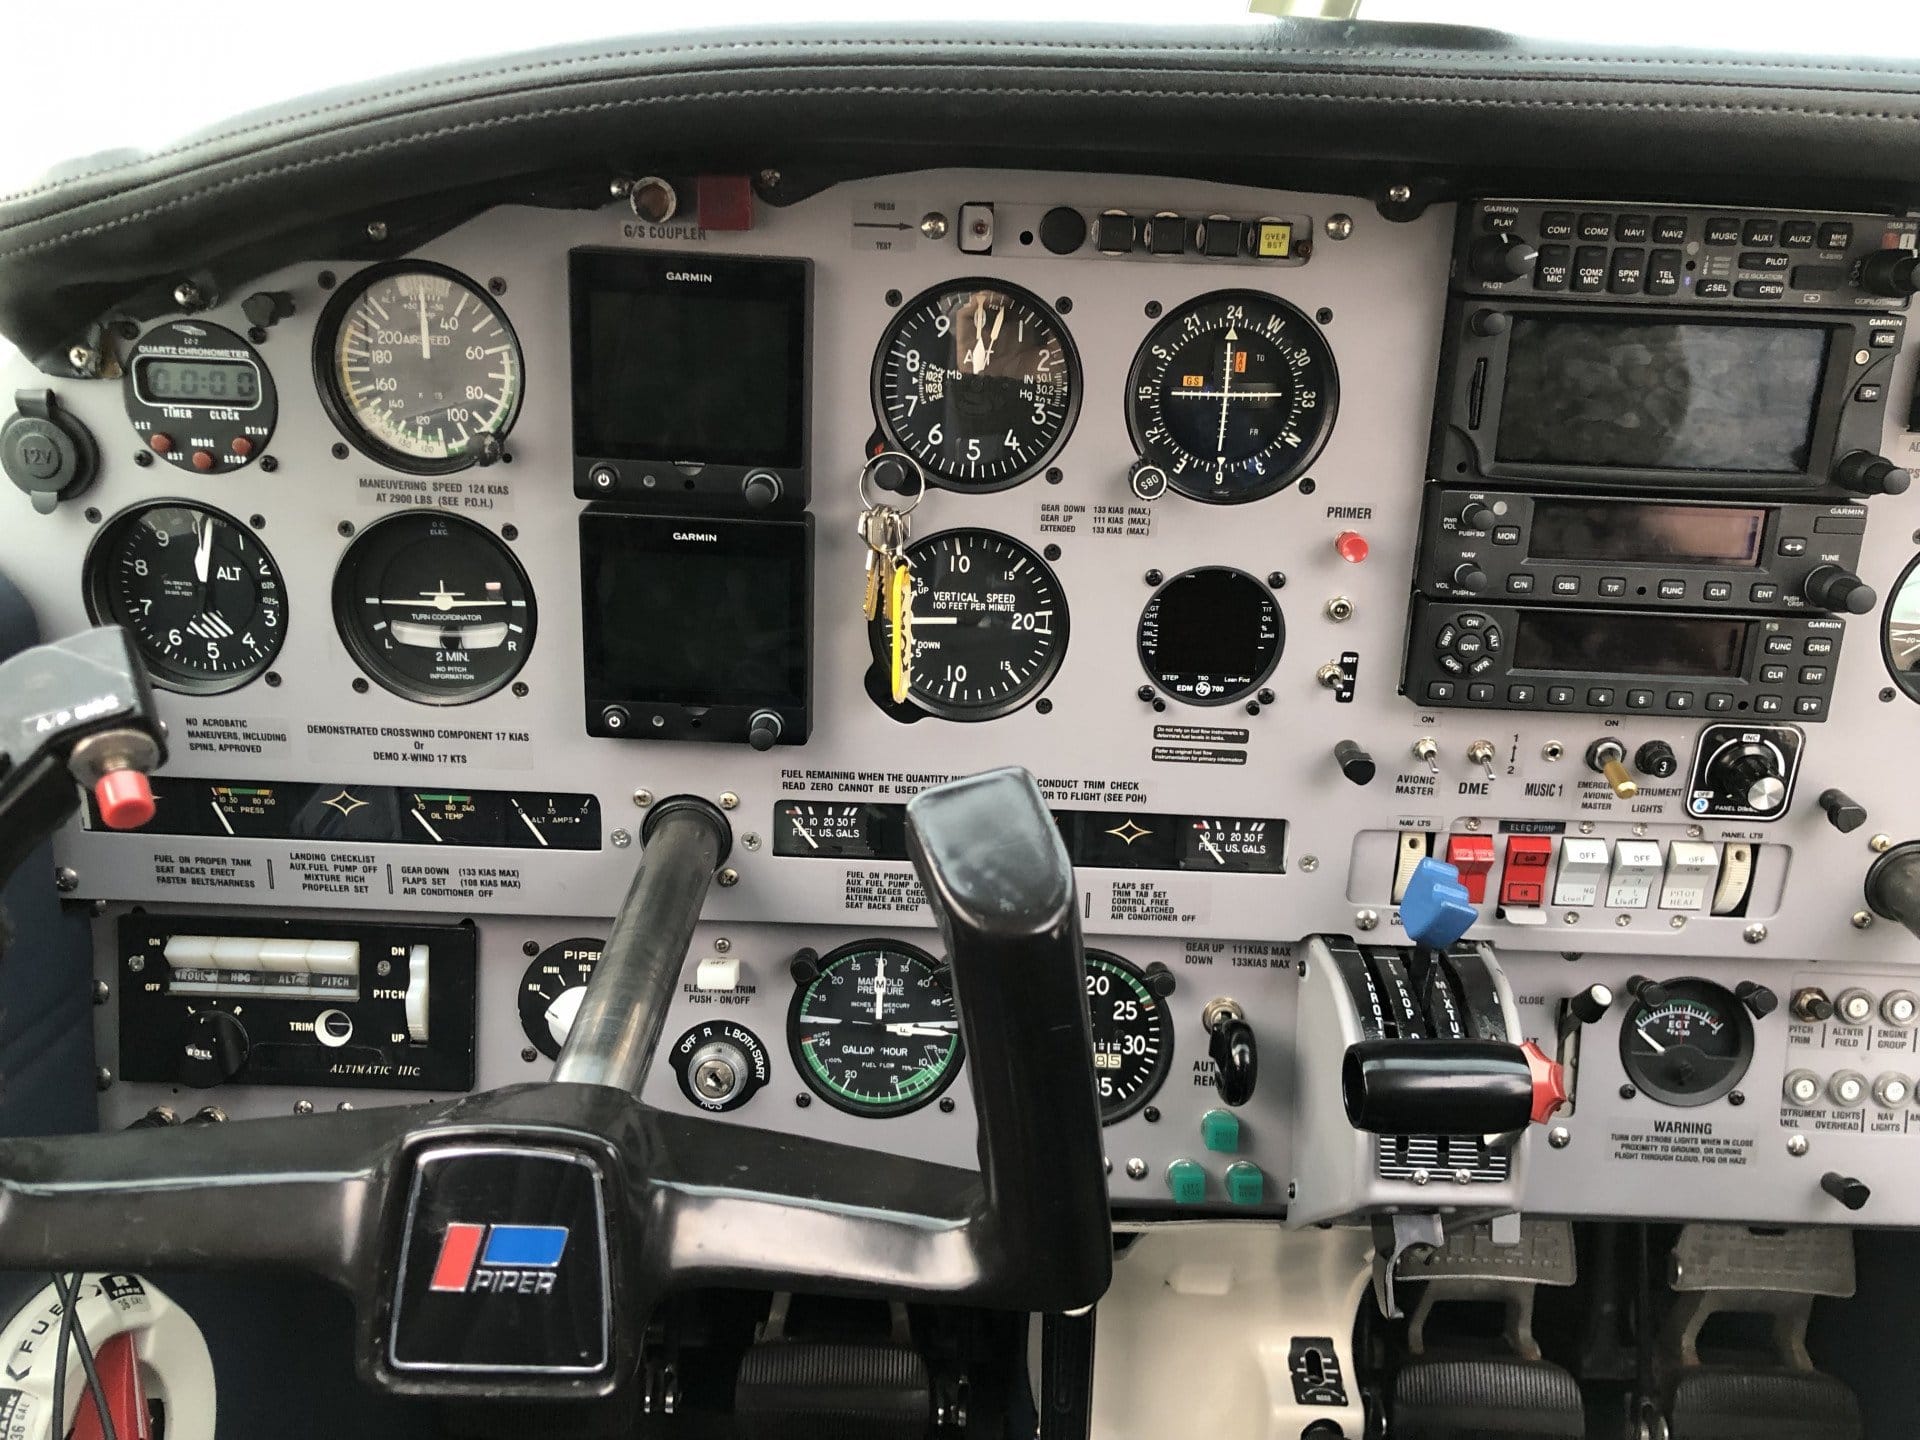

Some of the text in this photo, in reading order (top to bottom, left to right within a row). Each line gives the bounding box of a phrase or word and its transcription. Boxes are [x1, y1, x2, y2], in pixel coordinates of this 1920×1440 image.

[624, 226, 706, 241] G/S COUPLER
[1547, 226, 1571, 234] COM1
[1584, 227, 1609, 236] COM2
[1624, 228, 1645, 236] NAV1
[1661, 230, 1684, 238] NAV2
[1711, 232, 1738, 240] MUSIC
[1752, 234, 1773, 242] AUX1
[1789, 235, 1811, 243] AUX2
[1267, 241, 1283, 249] BST
[1765, 257, 1788, 266] PILOT
[1543, 267, 1566, 275] COM1
[1579, 269, 1603, 277] COM2
[666, 272, 712, 283] GARMIN
[1546, 275, 1563, 283] MIC
[1583, 276, 1599, 284] MIC
[1759, 286, 1784, 294] CREW
[1227, 305, 1243, 319] 24
[1869, 318, 1903, 326] GARMIN
[378, 330, 402, 345] 200
[138, 345, 250, 359] QUARTZ CHRONOMETER
[372, 350, 393, 364] 180
[465, 346, 484, 360] 60
[946, 370, 962, 380] Mb
[1186, 376, 1200, 386] GS
[465, 386, 484, 400] 80
[925, 384, 943, 393] 1020
[1035, 386, 1054, 395] 30.2
[1019, 389, 1033, 401] Hg
[163, 408, 192, 419] TIMER
[210, 410, 240, 421] CLOCK
[447, 408, 469, 422] 100
[966, 439, 981, 460] 5
[359, 478, 510, 496] MANEUVERING SPEED 124 KIAS
[1140, 474, 1159, 490] OBS
[376, 492, 494, 509] AT 2900 LBS (SEE P.O.H.)
[1041, 504, 1151, 516] GEAR DOWN 133 KIAS (MAX.)
[1326, 506, 1372, 519] PRIMER
[1830, 508, 1864, 516] GARMIN
[1040, 514, 1059, 522] GEAR
[1063, 515, 1073, 523] UP
[1093, 516, 1106, 524] 111
[1127, 517, 1151, 526] (MAX.)
[1040, 525, 1076, 533] EXTENDED
[1092, 526, 1105, 534] 133
[1126, 527, 1150, 536] (MAX.)
[672, 532, 717, 542] GARMIN
[1497, 532, 1516, 541] MON
[951, 555, 971, 573] 10
[216, 567, 241, 581] ALT
[918, 586, 929, 595] UP
[1558, 582, 1575, 590] OBS
[1661, 586, 1684, 595] FUNC
[933, 591, 1016, 604] VERTICAL SPEED
[1710, 588, 1726, 596] CLR
[1757, 590, 1773, 598] ENT
[932, 601, 1015, 612] 100 FEET PER MINUTE
[411, 613, 482, 622] TURN COORDINATOR
[1011, 613, 1035, 630] 20
[1808, 621, 1841, 629] GARMIN
[917, 641, 940, 650] DOWN
[1769, 642, 1792, 650] FUNC
[435, 652, 470, 662] 2 MIN.
[1176, 684, 1193, 692] EDM
[185, 718, 248, 728] NO ACROBATIC
[187, 730, 287, 742] MANEUVERS, INCLUDING
[307, 725, 530, 742] DEMONSTRATED CROSSWIND COMPONENT 17 KIAS
[189, 743, 262, 753] SPINS, APPROVED
[413, 741, 424, 750] Or
[373, 751, 467, 764] DEMO X-WIND 17 KTS
[781, 769, 949, 784] FUEL REMAINING WHEN THE QUANTITY
[1397, 774, 1435, 785] AVIONIC
[782, 782, 918, 795] READ ZERO CANNOT BE USED
[1037, 778, 1139, 791] CONDUCT TRIM CHECK
[1458, 782, 1489, 795] DME
[1524, 782, 1563, 797] MUSIC 1
[1395, 786, 1434, 796] MASTER
[1057, 792, 1148, 804] TO FLIGHT (SEE POH)
[1631, 804, 1663, 814] LIGHTS
[836, 828, 860, 838] GALS
[290, 852, 375, 864] LANDING CHECKLIST
[1185, 943, 1292, 956] GEAR UP 111KIAS MAX
[1185, 956, 1290, 968] DOWN 133KIAS MAX
[543, 966, 560, 974] OMNI
[373, 989, 405, 999] PITCH
[688, 994, 751, 1005] PUSH ON/OFF
[1396, 979, 1415, 1019] PROP
[1519, 995, 1545, 1005] CLOSE
[1112, 1001, 1138, 1020] 25
[289, 1022, 314, 1032] TRIM
[680, 1033, 698, 1053] OFF
[732, 1028, 757, 1052] BOTH
[1122, 1035, 1146, 1055] 30
[1835, 1038, 1859, 1047] FIELD
[1877, 1040, 1907, 1049] GROUP
[330, 1063, 392, 1076] ALTIMATIC
[752, 1049, 765, 1080] START
[1653, 1120, 1712, 1135] WARNING
[1815, 1121, 1859, 1130] OVERHEAD
[471, 1269, 558, 1294] PIPER
[112, 1286, 141, 1296] TANK
